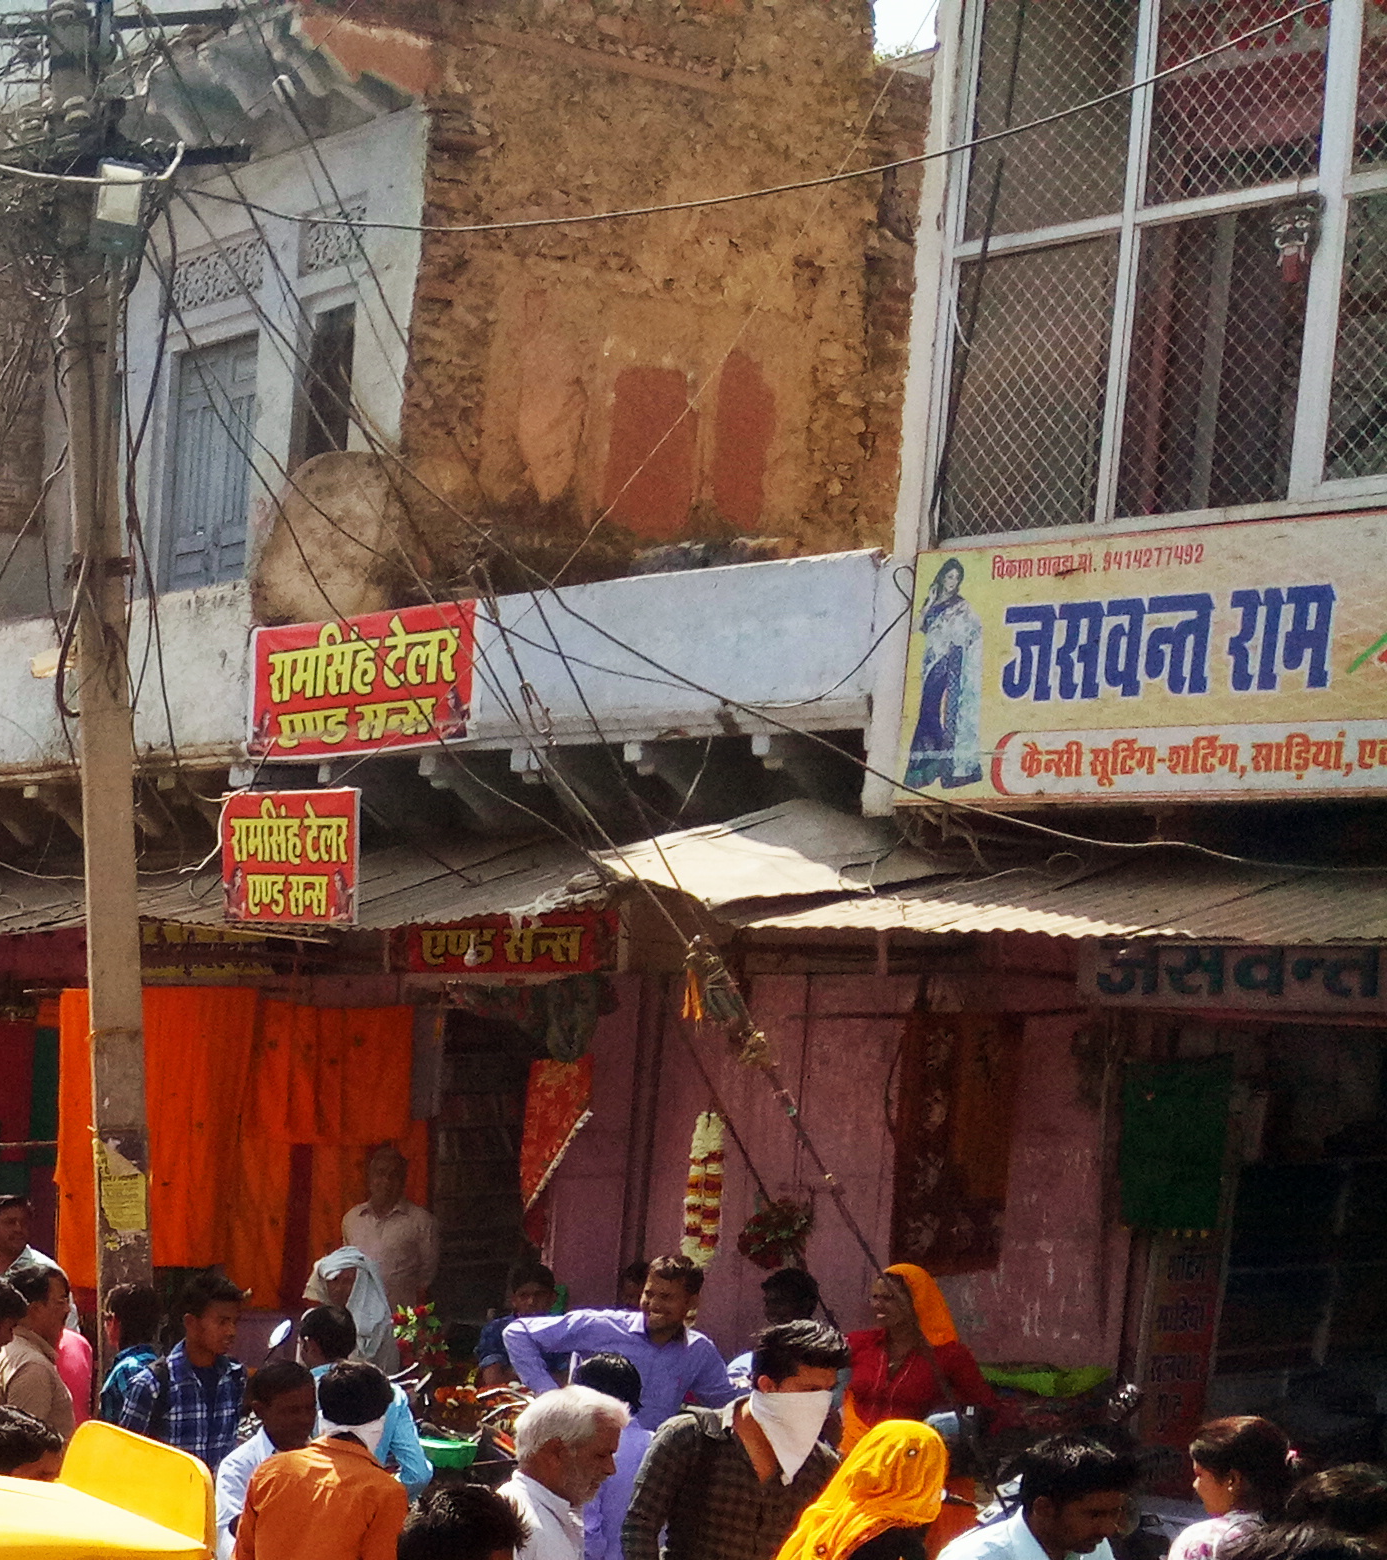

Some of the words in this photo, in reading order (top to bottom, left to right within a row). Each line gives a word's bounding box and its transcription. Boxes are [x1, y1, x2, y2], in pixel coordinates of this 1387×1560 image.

[1102, 543, 1205, 572] 9414277492
[268, 622, 376, 702] रामसिंह
[383, 615, 461, 687] टेलर
[1002, 592, 1215, 702] जसवन्त
[1227, 583, 1336, 692] राम
[278, 710, 348, 748] एण्ड
[355, 697, 437, 741] सन्स
[230, 798, 301, 864] रामसिंह
[305, 799, 348, 863] टेलर
[246, 874, 284, 918] एण्ड
[287, 874, 329, 917] सन्स
[420, 928, 494, 967] एण्ड
[504, 926, 585, 966] सन्स
